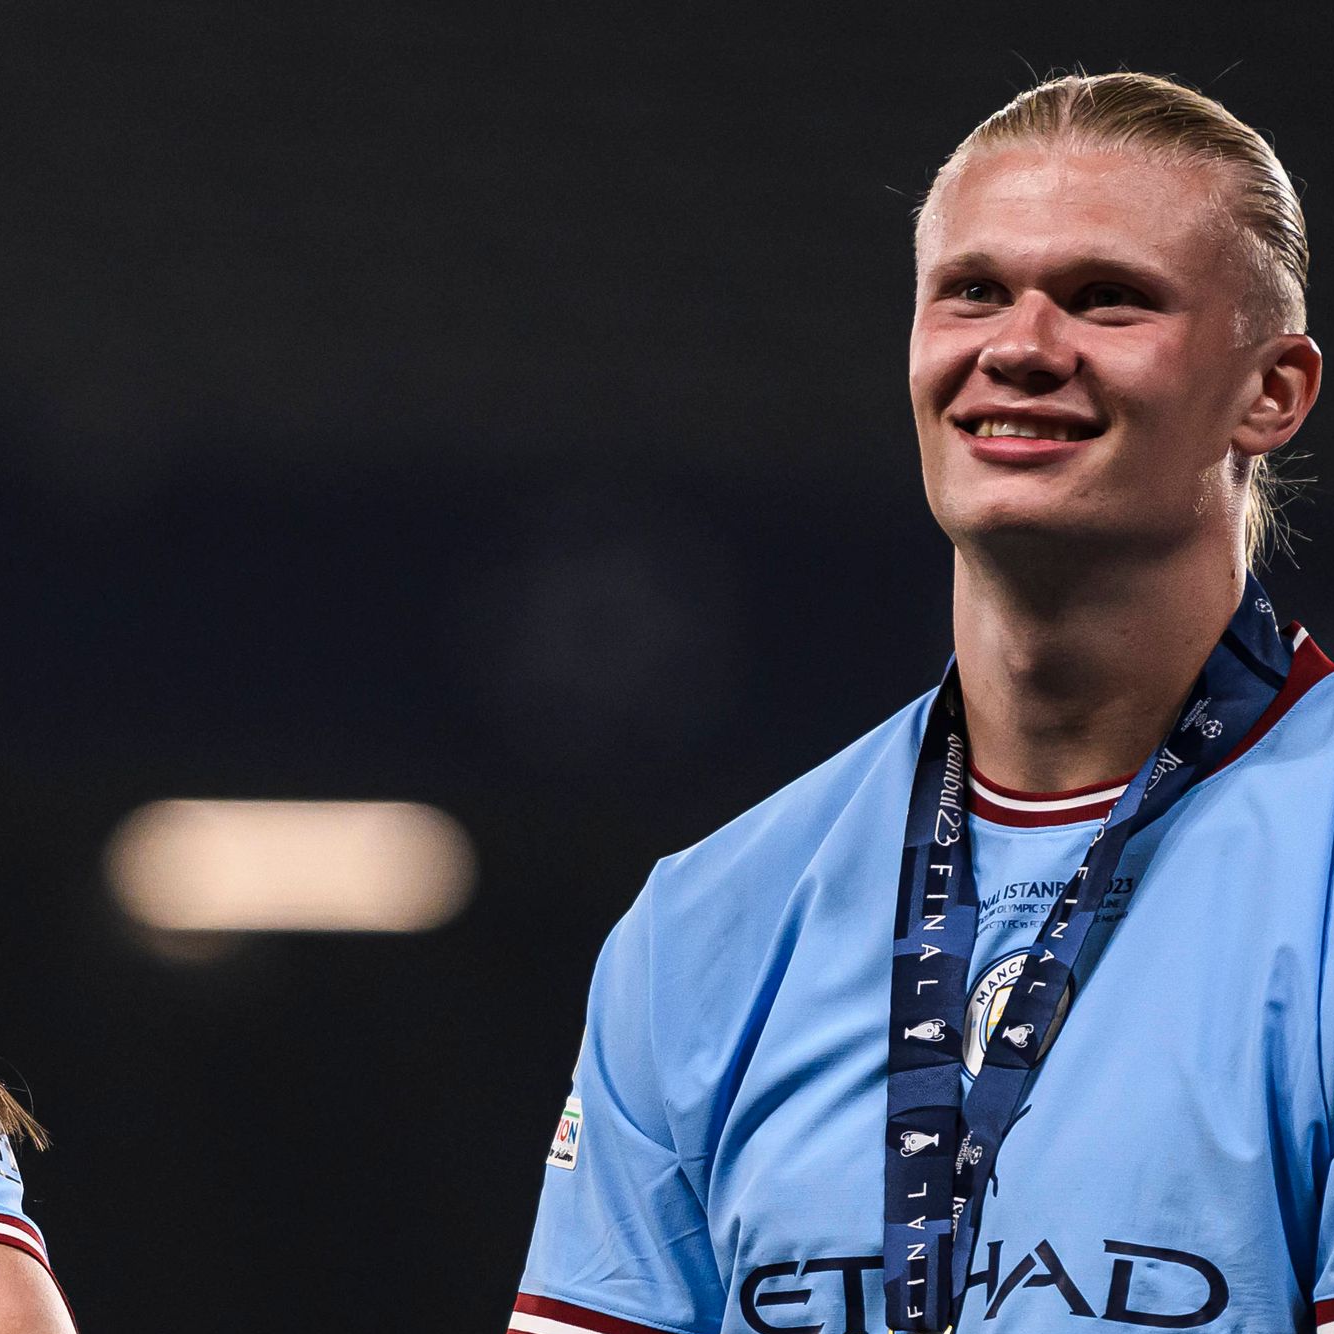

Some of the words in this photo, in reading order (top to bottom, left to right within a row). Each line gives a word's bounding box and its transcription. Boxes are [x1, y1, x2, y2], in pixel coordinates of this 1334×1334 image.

[917, 863, 953, 995] FINAL
[1028, 866, 1089, 994] FINAL
[907, 1181, 927, 1319] FINAL
